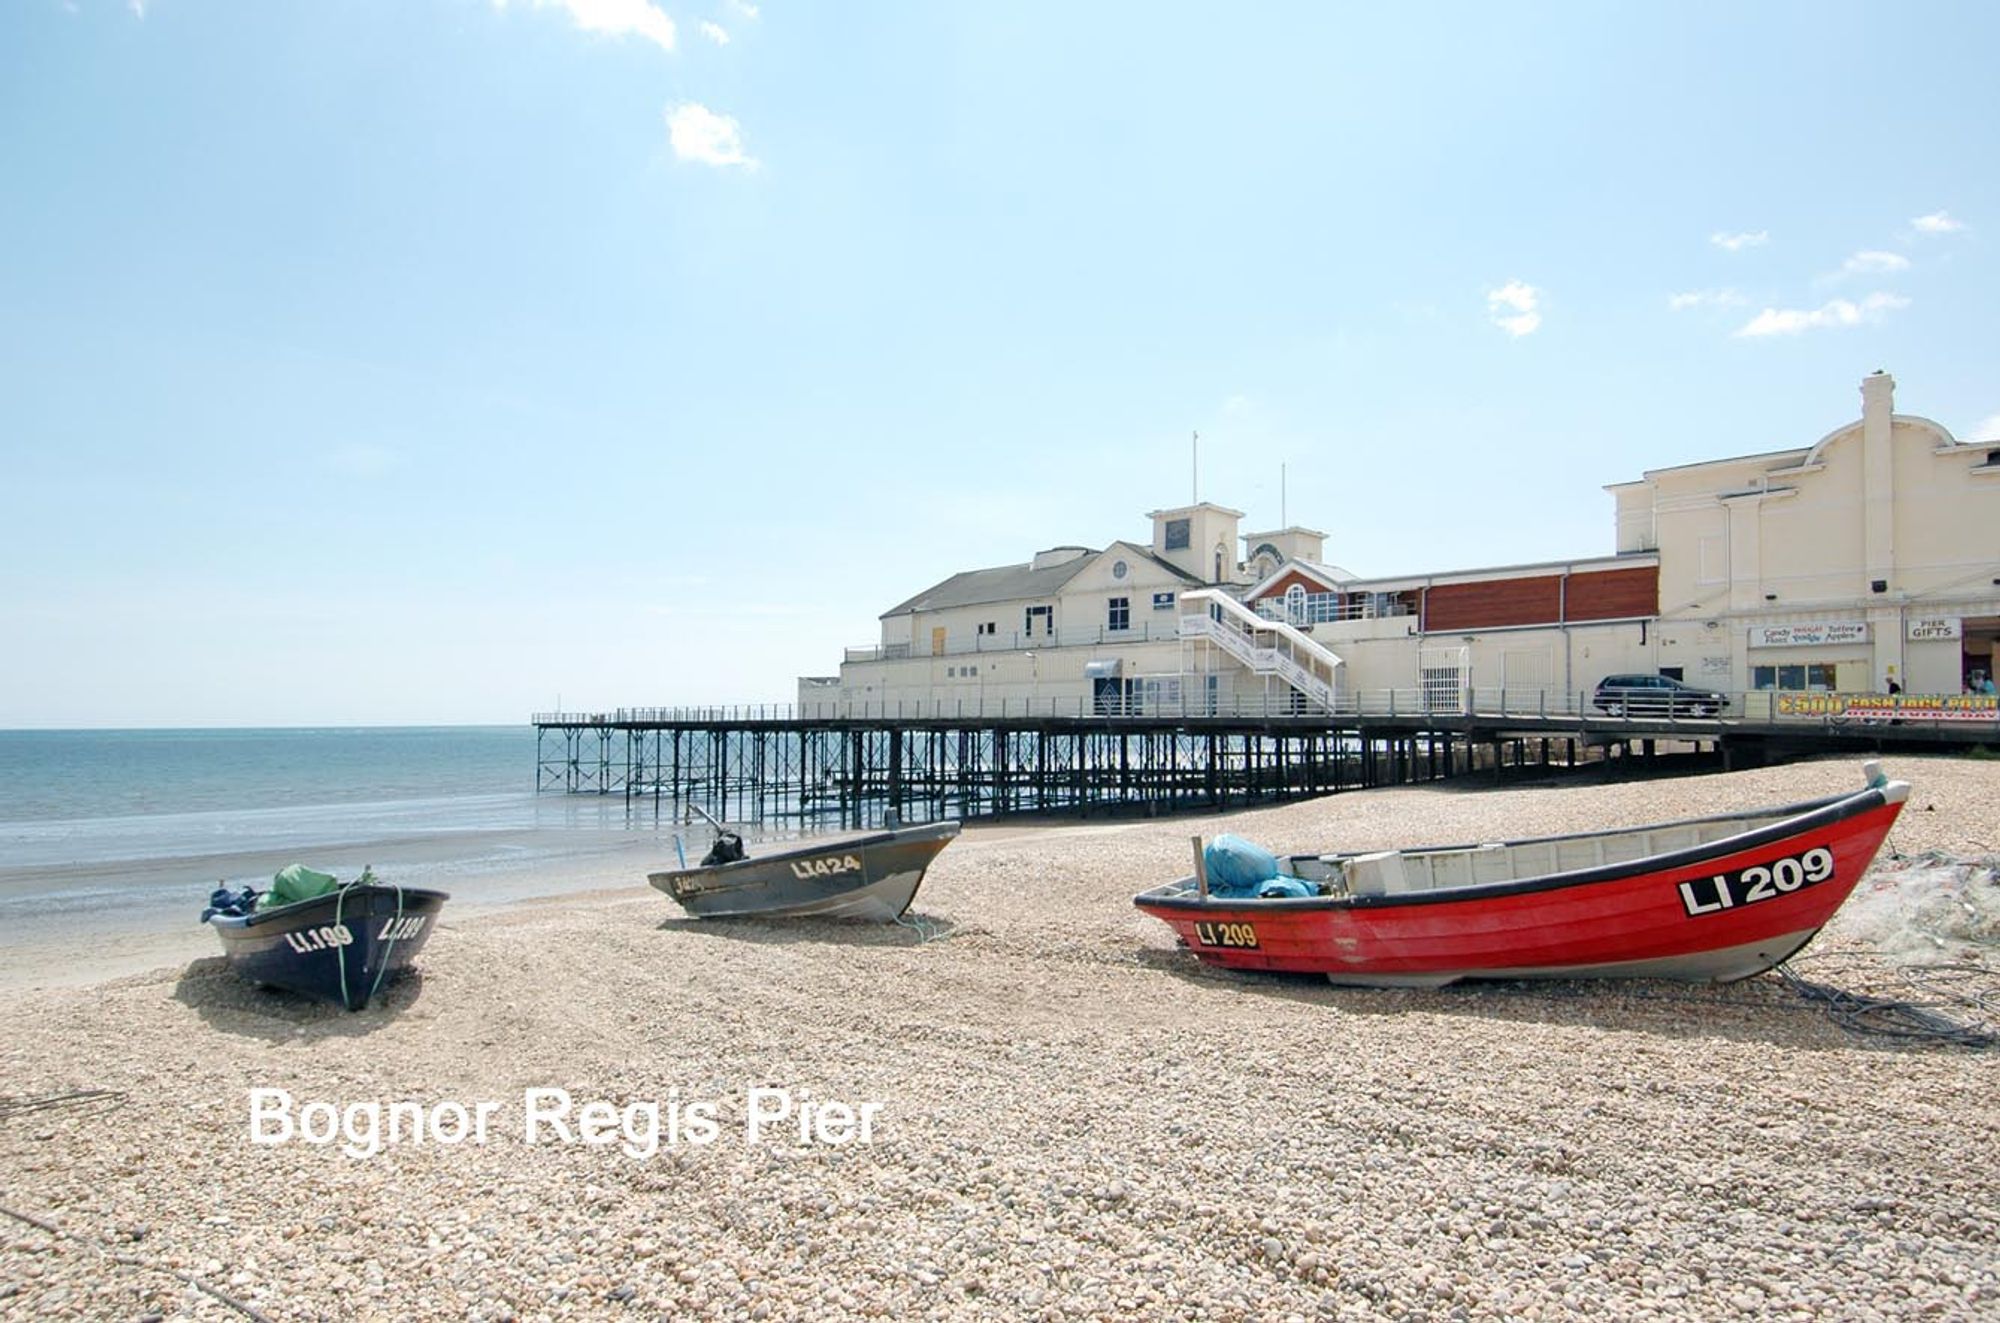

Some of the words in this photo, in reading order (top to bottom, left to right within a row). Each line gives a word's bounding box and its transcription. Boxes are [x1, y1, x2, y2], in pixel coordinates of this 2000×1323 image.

[1912, 626, 1953, 637] GIFTS
[1779, 694, 1842, 715] £500
[790, 855, 861, 880] LI424
[1679, 875, 1734, 916] LI
[1740, 848, 1834, 903] 209
[1195, 923, 1217, 945] LI
[1218, 923, 1257, 947] 209
